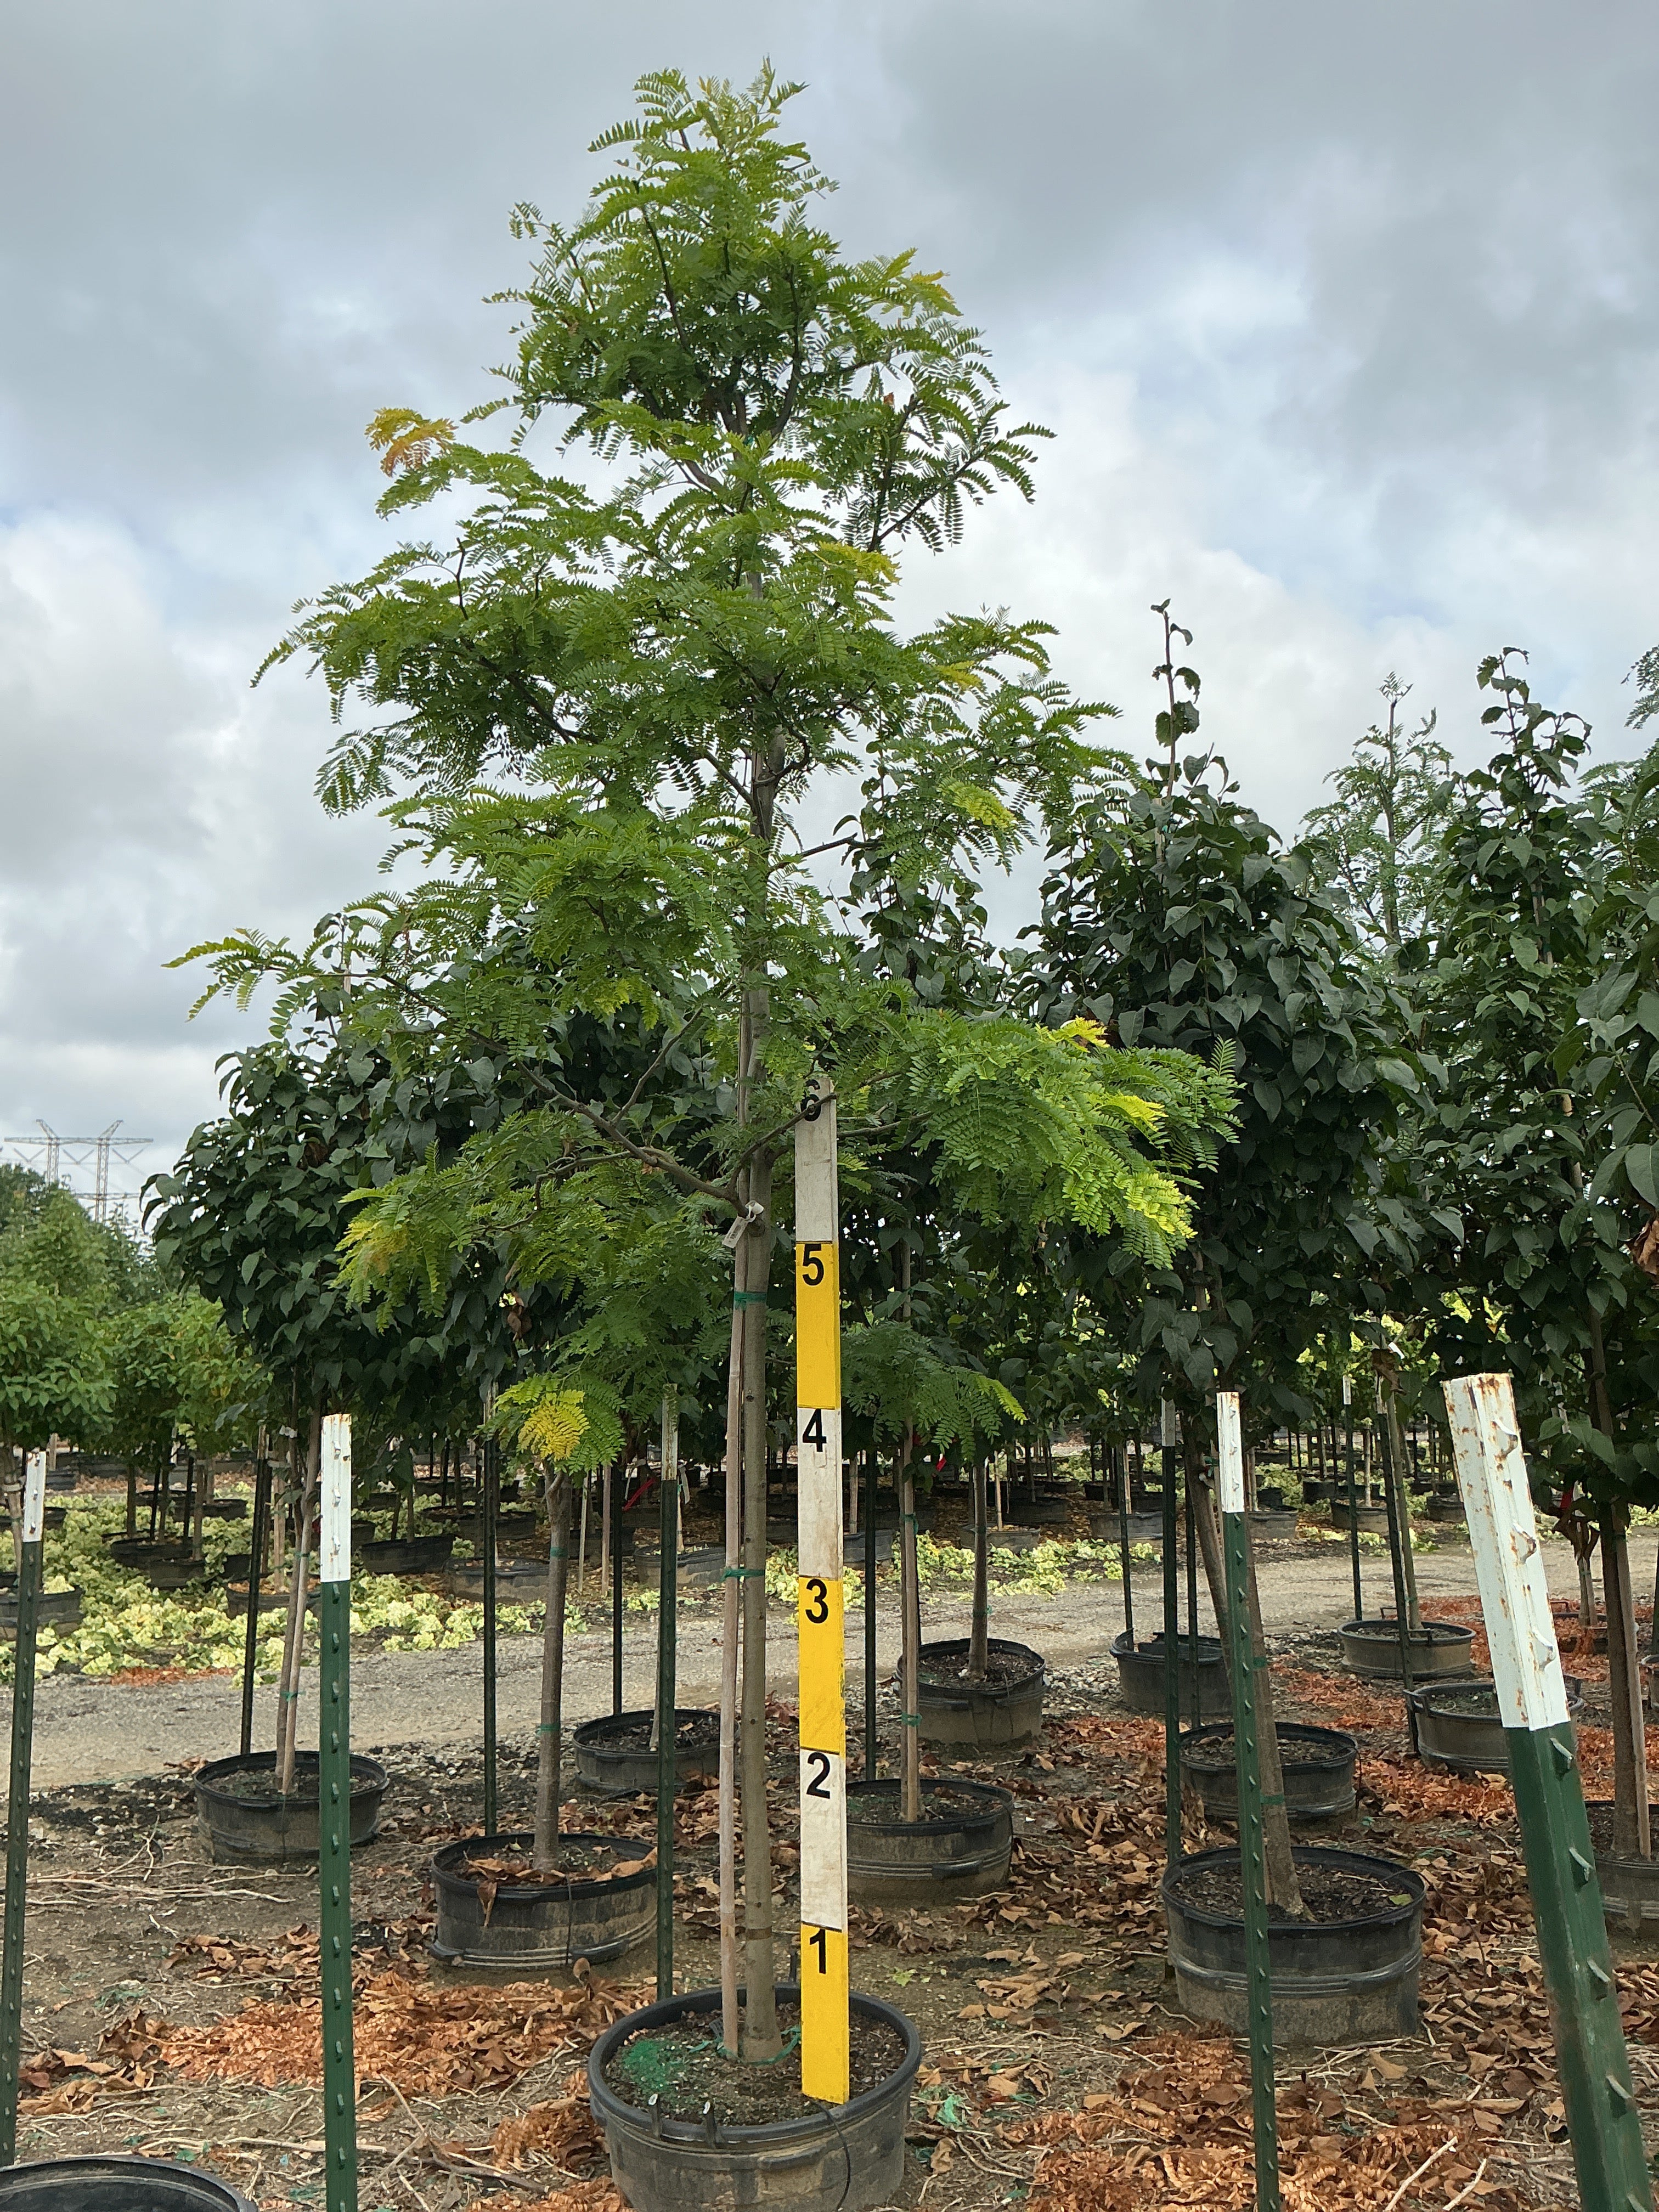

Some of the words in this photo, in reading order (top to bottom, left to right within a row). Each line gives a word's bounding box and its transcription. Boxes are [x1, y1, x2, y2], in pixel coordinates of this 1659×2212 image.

[803, 1244, 824, 1286] 5
[802, 1409, 827, 1452] 4
[805, 1578, 829, 1624] 3
[806, 1752, 831, 1799] 2
[809, 1929, 826, 1974] 1
